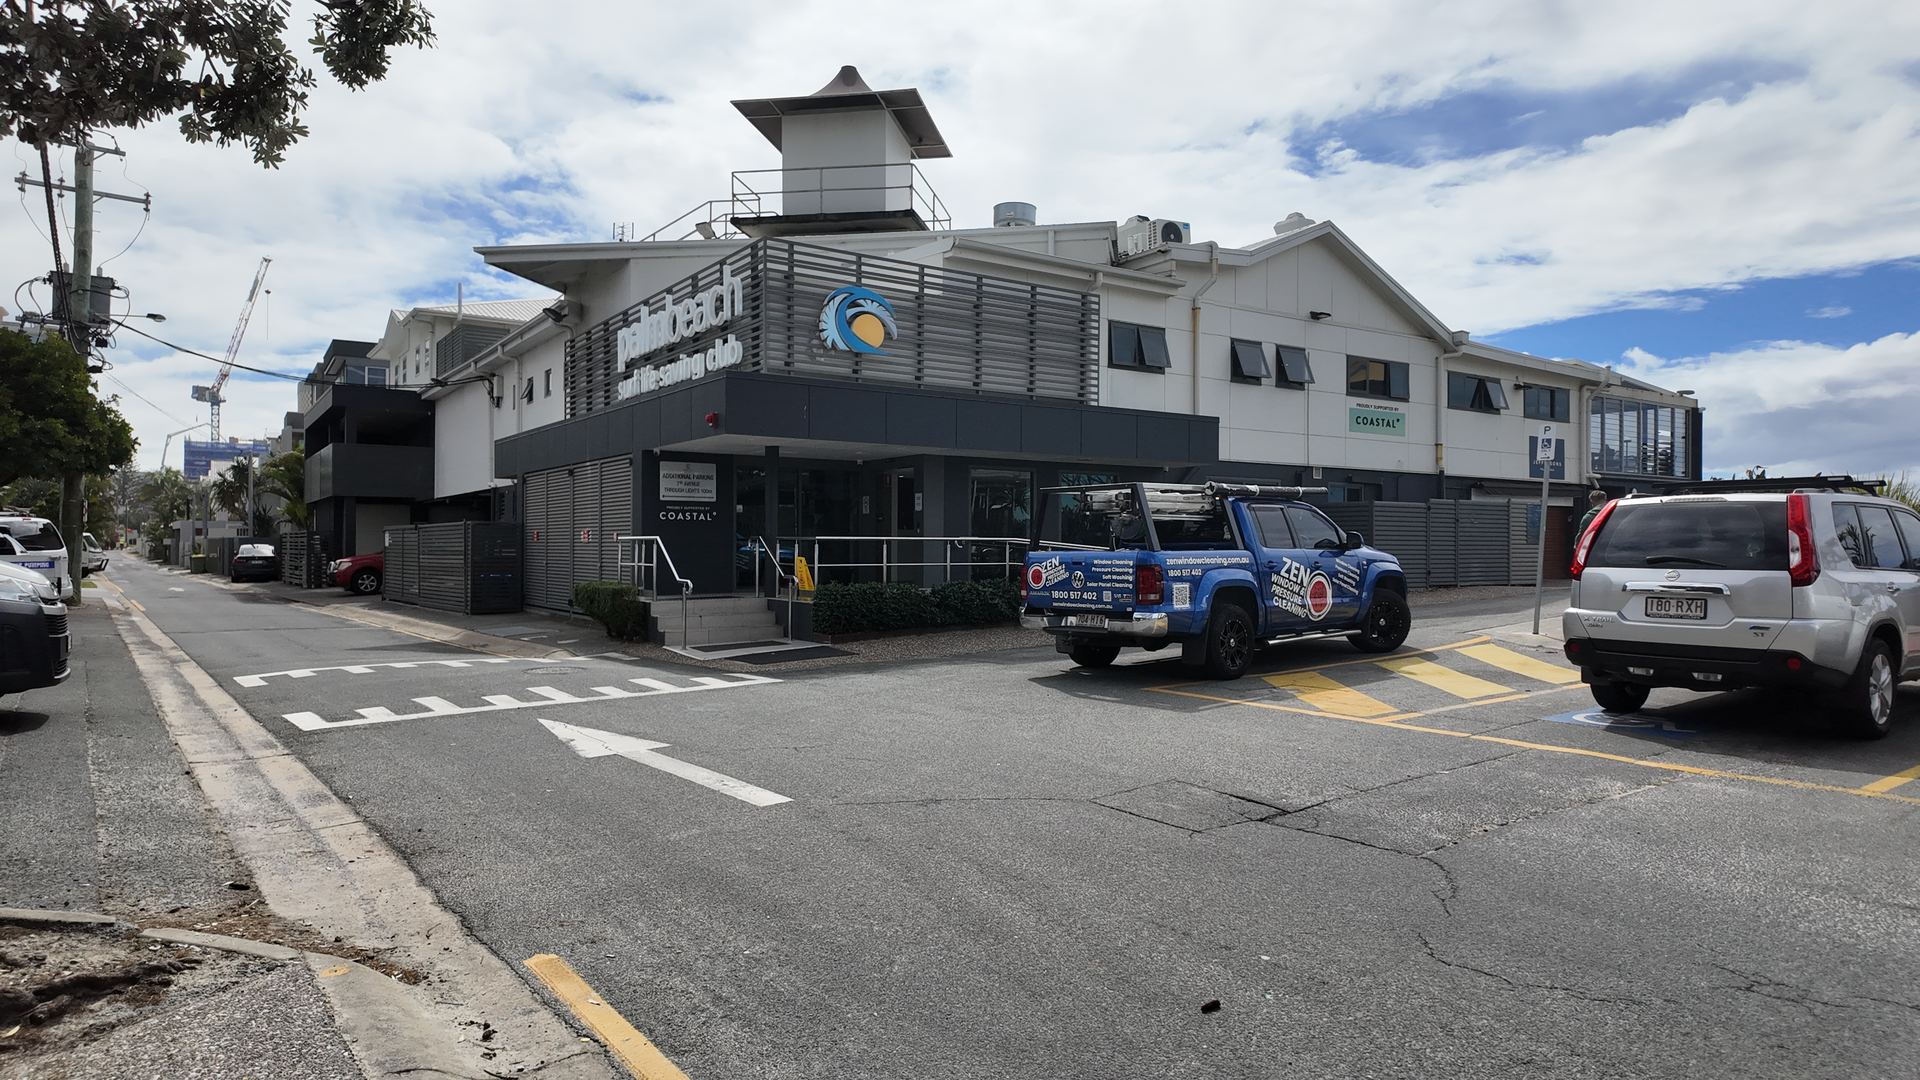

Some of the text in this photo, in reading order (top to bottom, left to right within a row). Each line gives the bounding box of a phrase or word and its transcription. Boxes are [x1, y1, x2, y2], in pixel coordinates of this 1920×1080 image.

[660, 354, 705, 387] saving
[706, 334, 743, 371] club
[1355, 415, 1397, 429] COASTAL
[1544, 425, 1551, 435] P
[659, 511, 712, 521] COASTAL
[1041, 555, 1060, 572] ZEN
[1166, 556, 1250, 566] zenwindowcleaning.com.au
[1167, 569, 1182, 577] 1800
[1191, 568, 1202, 576] 402
[1280, 556, 1311, 588] ZEN
[1271, 572, 1301, 593] WINDOW
[1051, 590, 1097, 600] 1800 517 402
[1270, 583, 1303, 605] PRESSURE
[1272, 596, 1308, 618] CLEANING
